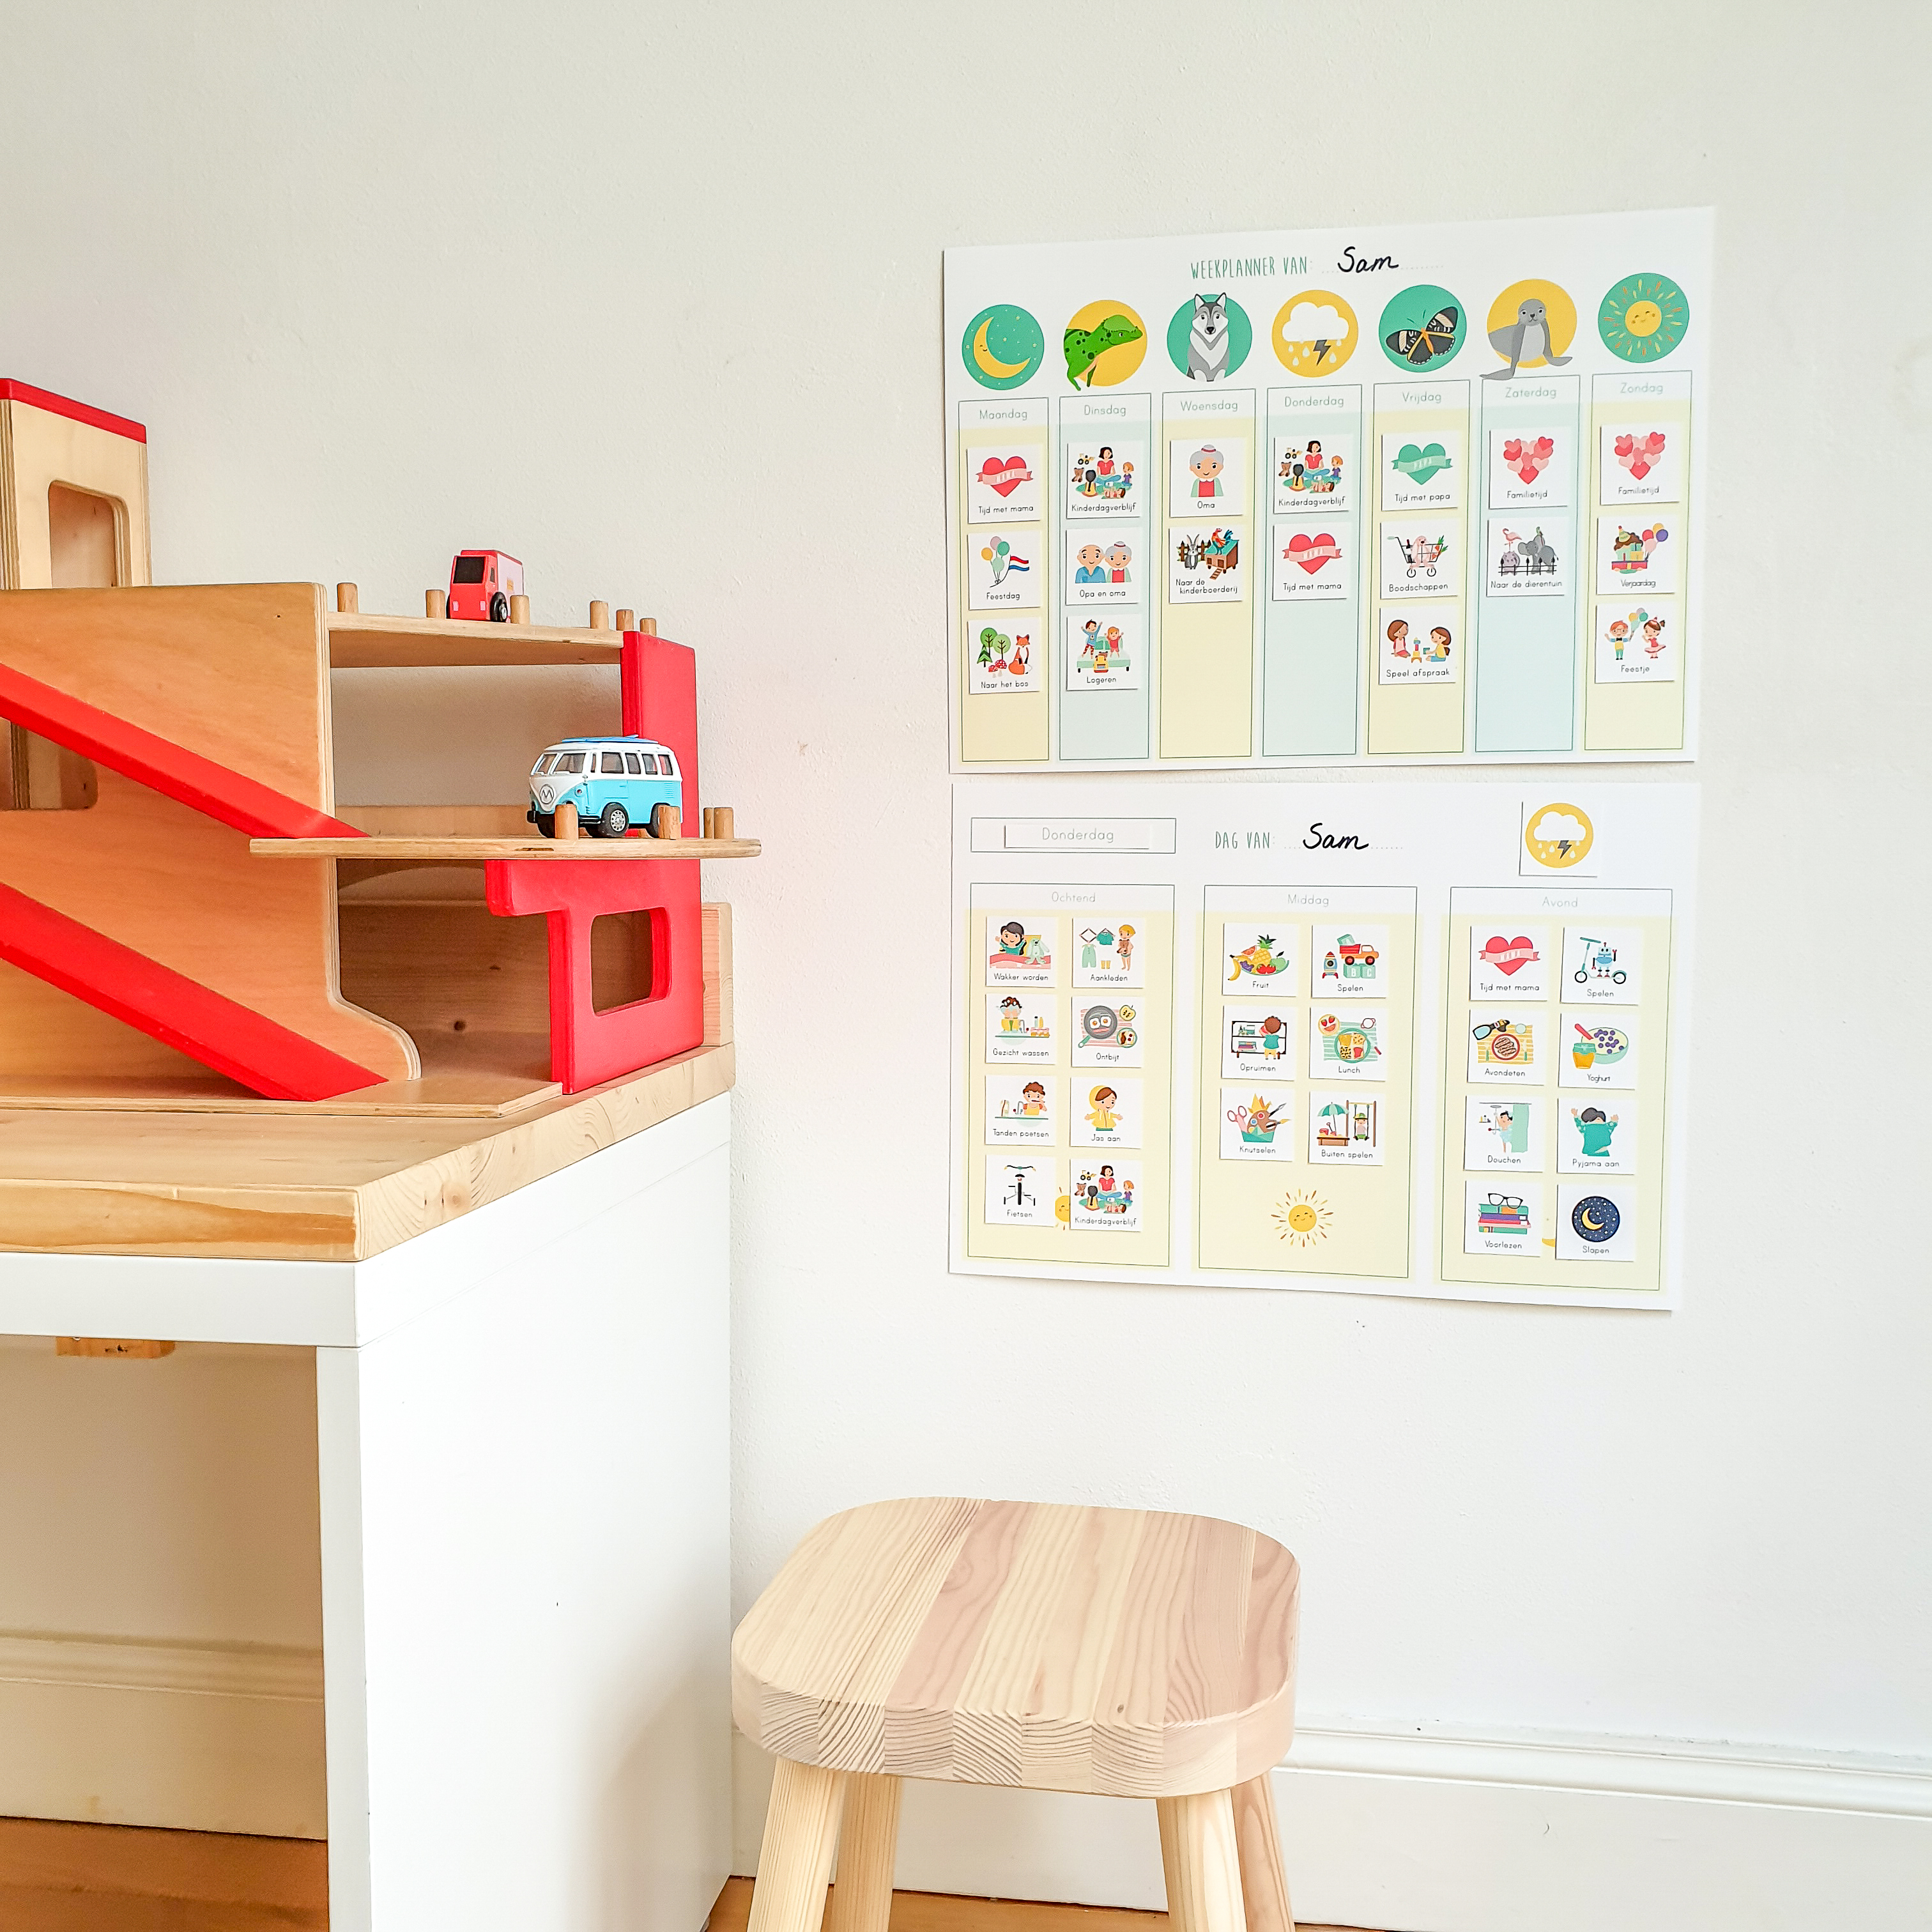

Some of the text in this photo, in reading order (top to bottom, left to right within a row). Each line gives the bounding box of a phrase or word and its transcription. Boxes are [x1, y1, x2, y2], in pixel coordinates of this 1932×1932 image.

[1338, 247, 1399, 273] Sam
[1190, 256, 1275, 280] WEEKPLANNER
[1505, 386, 1557, 399] Zaterdag
[1620, 381, 1664, 395] Zondag
[1284, 395, 1344, 408] Donderdag
[1402, 391, 1441, 404] Vrijdag
[1084, 404, 1126, 417] Dinsdag
[1180, 399, 1238, 412] Woensdag
[979, 408, 1027, 421] Maandag
[1506, 490, 1548, 500] Familietijd
[1618, 486, 1660, 496] Familietijd
[1279, 496, 1346, 507] Kinderdagverblijf
[1395, 493, 1408, 504] Tijd
[1429, 494, 1450, 502] papa
[1071, 502, 1137, 513] Kinderdagverblijf
[1197, 500, 1215, 509] Oma
[979, 506, 992, 515] Tijd
[1283, 583, 1296, 593] Tijd
[1389, 583, 1448, 592] Boodschappen
[1512, 580, 1522, 588] de
[1524, 579, 1562, 588] dierentuin
[1079, 589, 1095, 599] Opa
[1179, 585, 1238, 595] kinderboerderij
[986, 592, 1020, 601] Feestdag
[1386, 668, 1450, 679] Speel afspraak
[1620, 664, 1650, 674] Feestje
[1086, 676, 1117, 686] Logeren
[1042, 827, 1114, 844] Donderdag
[1215, 831, 1238, 849] DAG
[1303, 823, 1368, 850] Sam
[1051, 891, 1096, 903] Ochtend
[1287, 894, 1329, 908] Middag
[1542, 896, 1579, 908] Avond
[1337, 983, 1363, 993] Spelen
[1480, 983, 1493, 993] Tijd
[1586, 988, 1614, 999] Spelen
[993, 1048, 1019, 1056] Gezicht
[1096, 1052, 1119, 1062] Ontbijt
[1239, 1063, 1276, 1072] Opruimen
[1484, 1068, 1526, 1077] Avondeten
[1586, 1073, 1611, 1084] Yoghurt
[992, 1128, 1017, 1137] Tanden
[1091, 1133, 1104, 1142] Jas
[1239, 1146, 1276, 1154] Knutselen
[1321, 1149, 1373, 1160] Buiten spelen
[1487, 1154, 1521, 1163] Douchen
[1572, 1158, 1602, 1169] Pyjama
[1007, 1209, 1032, 1218] Fietsen
[1075, 1216, 1137, 1227] Kinderdagverblijf
[1485, 1240, 1522, 1249] Voorlezen
[1582, 1245, 1609, 1255] Slapen
